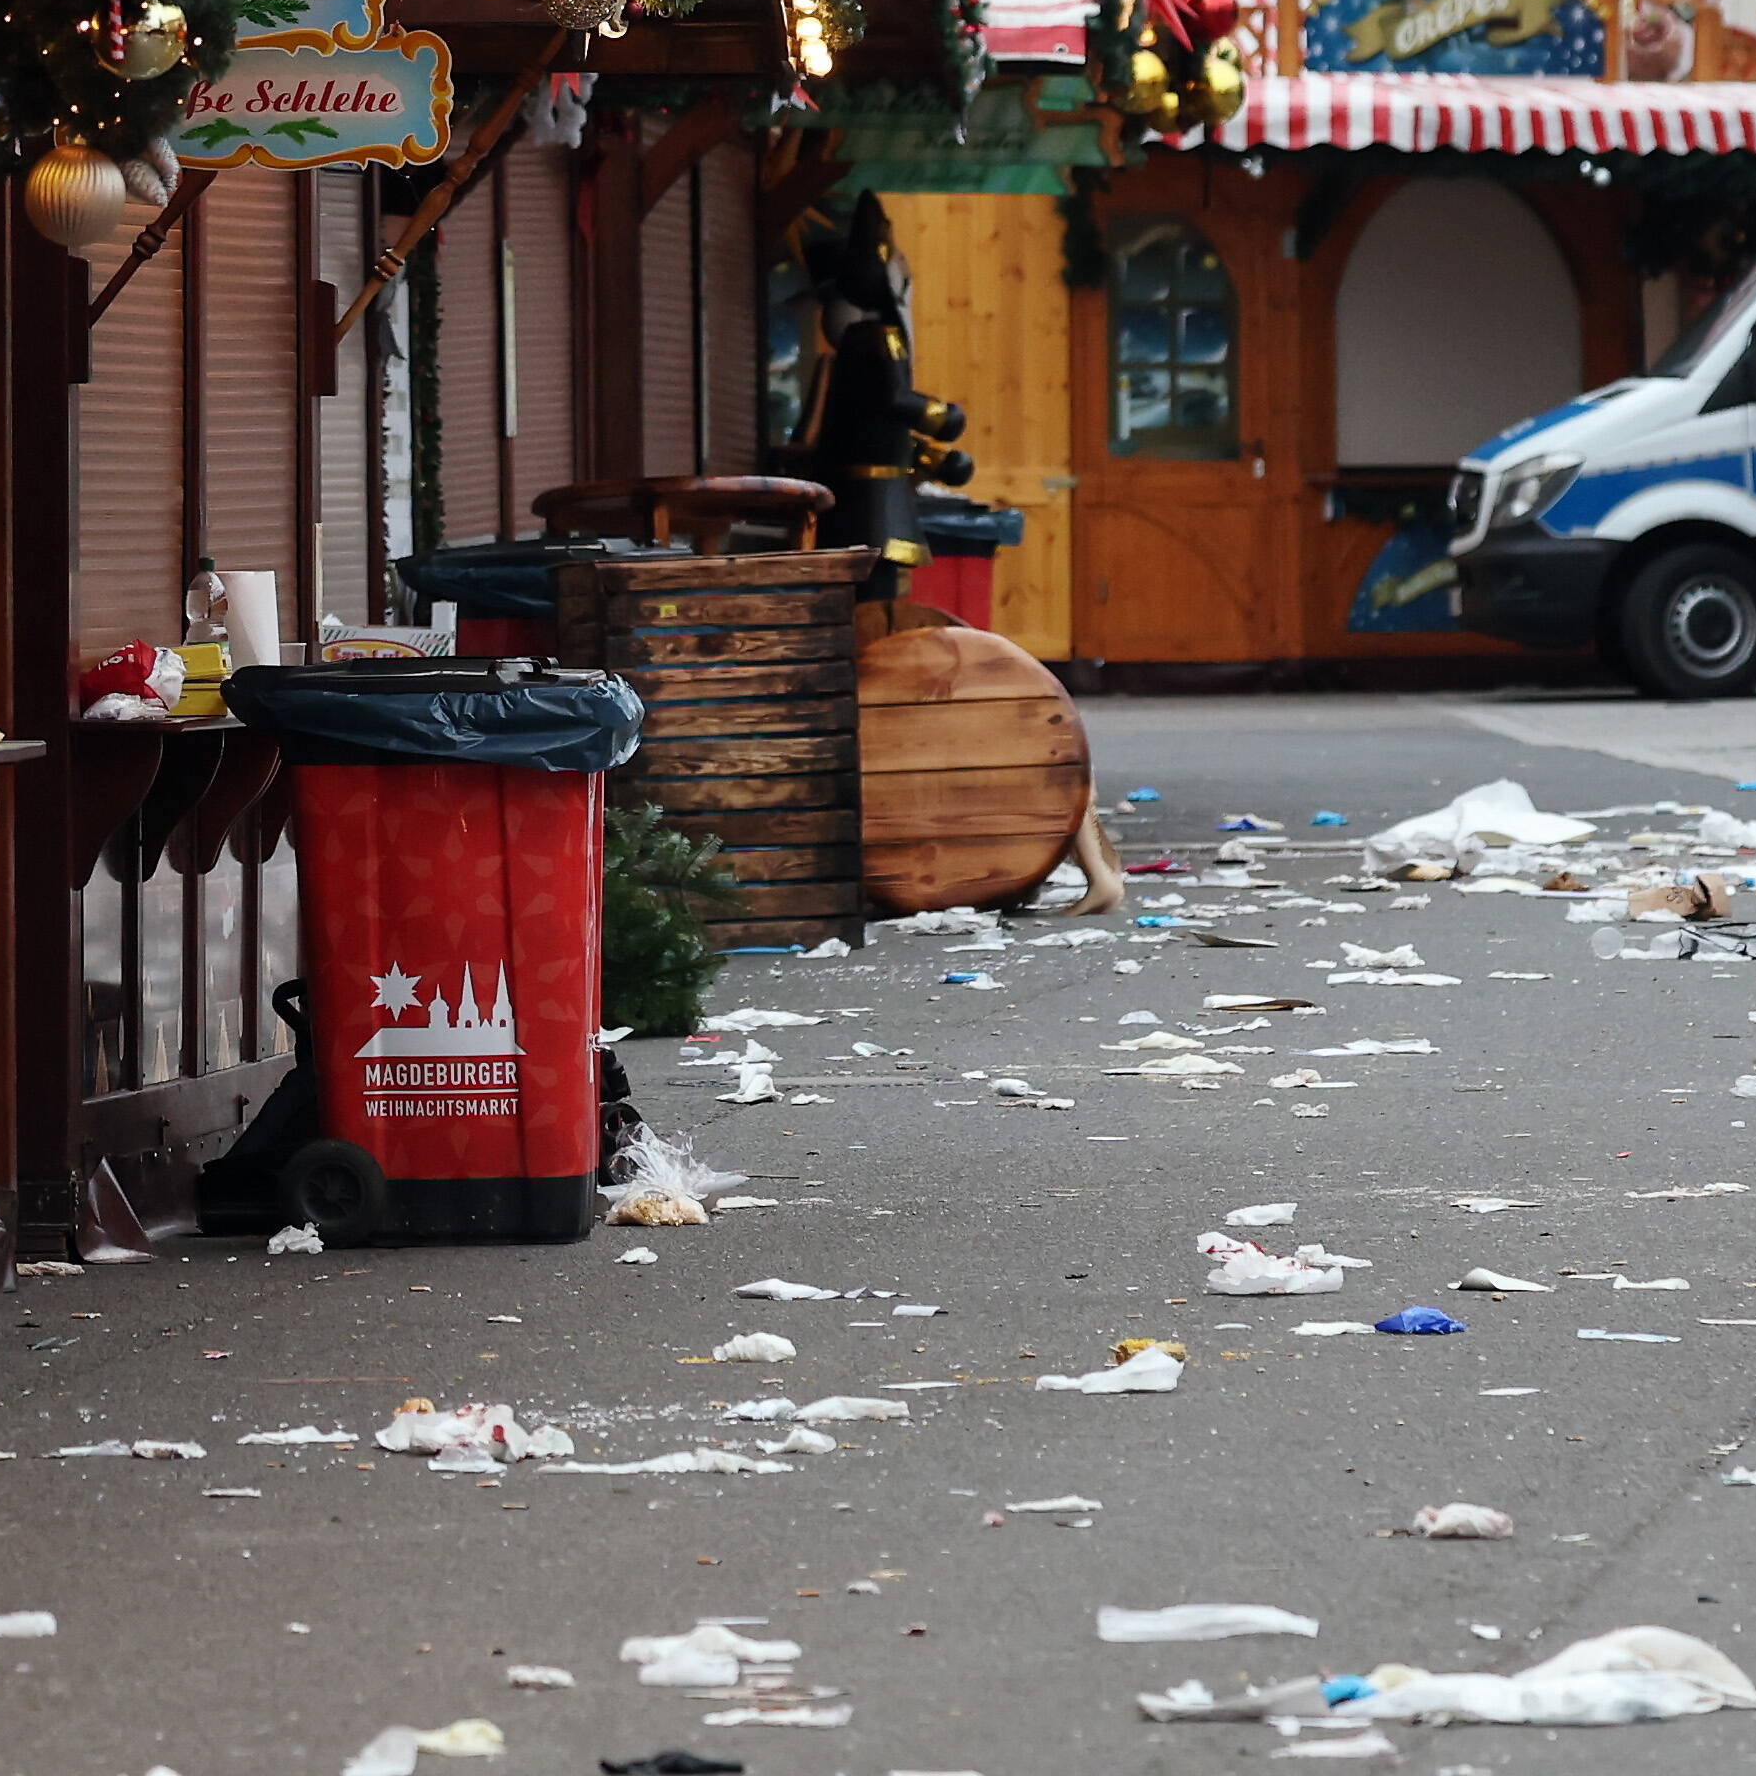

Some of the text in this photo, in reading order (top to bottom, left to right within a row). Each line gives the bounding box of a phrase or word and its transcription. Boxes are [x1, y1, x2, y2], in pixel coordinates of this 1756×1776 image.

[245, 78, 400, 114] Schlehe
[365, 1062, 518, 1086] MAGDEBURGER
[366, 1098, 519, 1117] WEIHNACHTSMARKT
